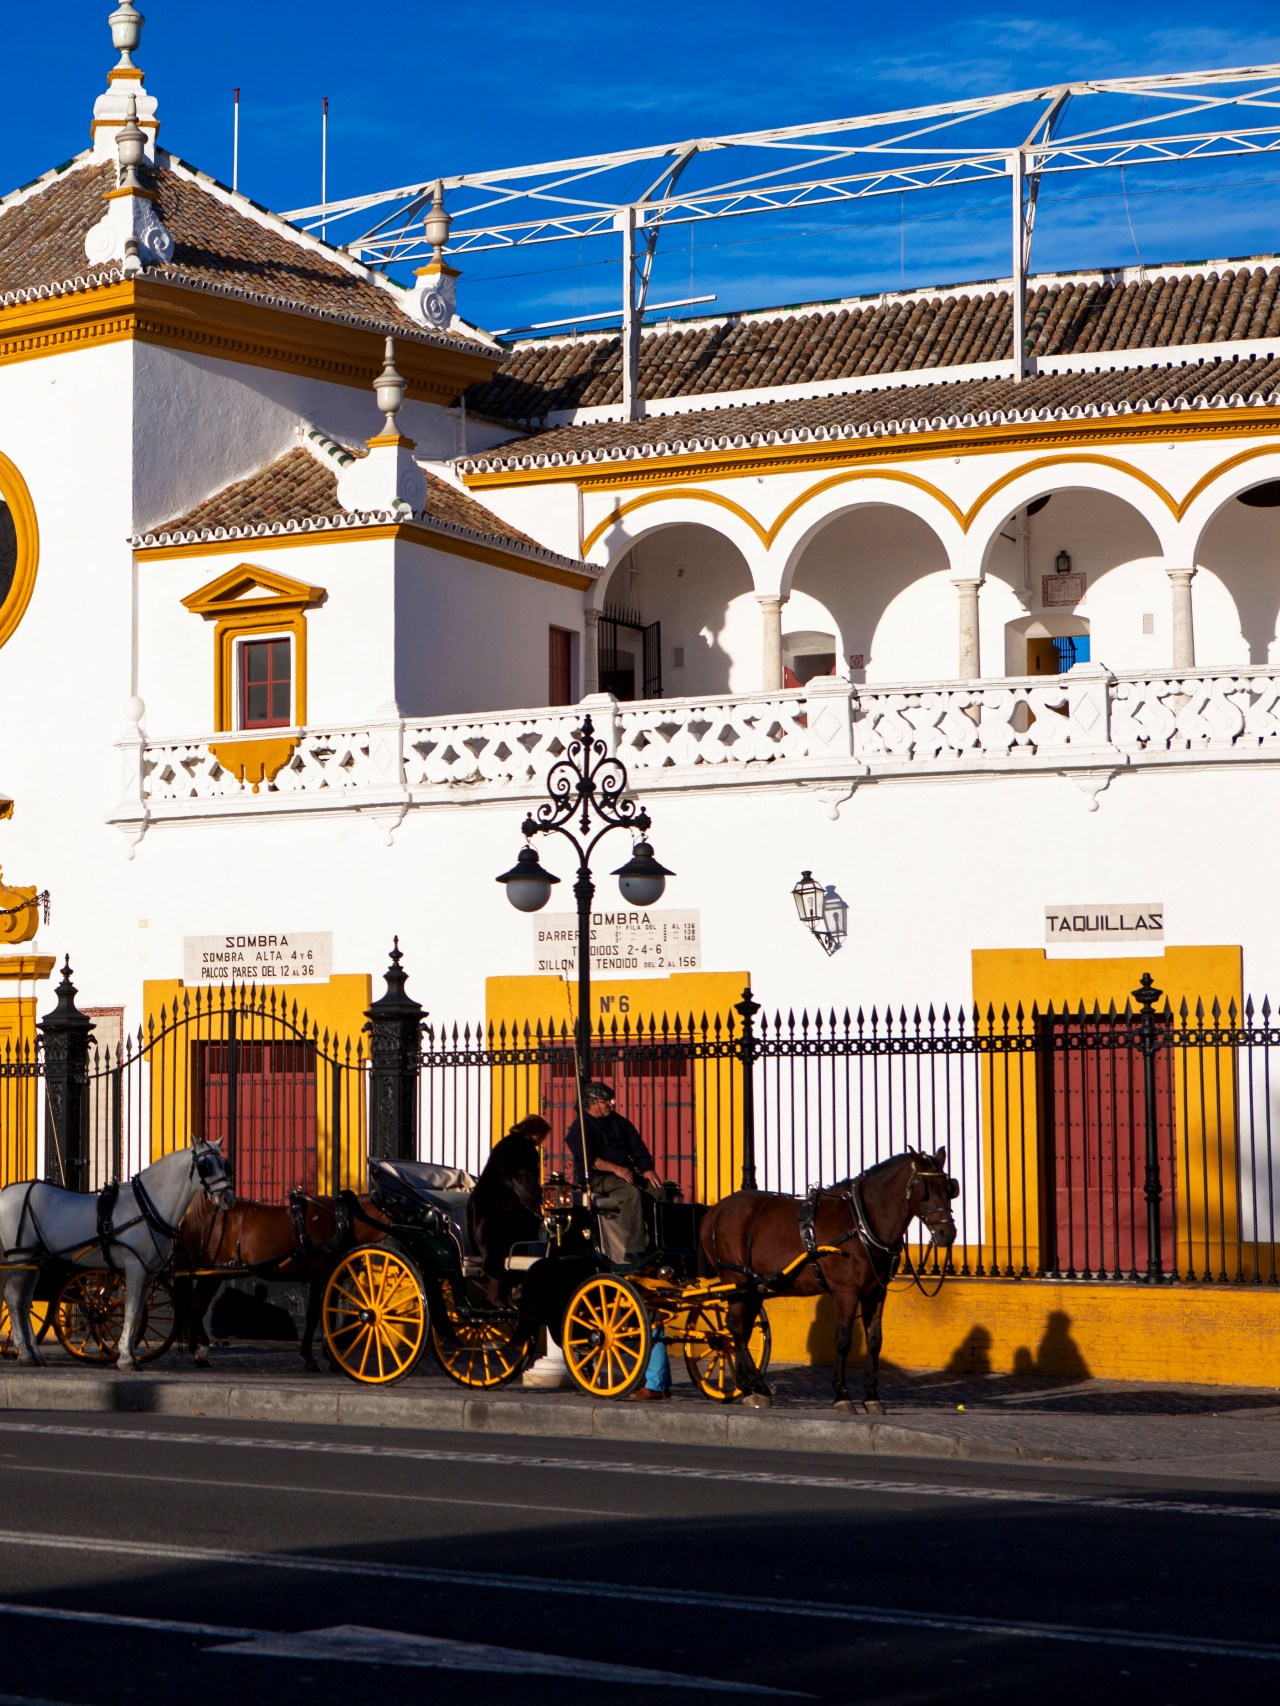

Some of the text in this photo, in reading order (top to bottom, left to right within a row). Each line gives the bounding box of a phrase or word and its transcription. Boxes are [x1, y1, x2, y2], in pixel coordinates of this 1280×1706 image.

[592, 912, 651, 926] OMBRA
[1046, 914, 1163, 932] TAQUILLAS
[225, 935, 288, 948] SOMBRA
[538, 930, 597, 941] BARRERS
[202, 952, 244, 963] SOMBRA
[256, 951, 282, 961] ALTA
[291, 950, 297, 960] 4
[307, 950, 313, 960] 6
[572, 944, 662, 957] TDIDOS 2-4-6
[538, 959, 574, 971] SILLON
[596, 957, 638, 969] TENDIDO
[658, 957, 664, 968] 2
[679, 956, 696, 967] 156
[201, 967, 228, 978] PALCOS
[232, 966, 257, 978] PARES
[261, 966, 277, 977] DEL
[280, 965, 289, 977] 12
[301, 965, 314, 976] 36
[619, 995, 629, 1013] 6
